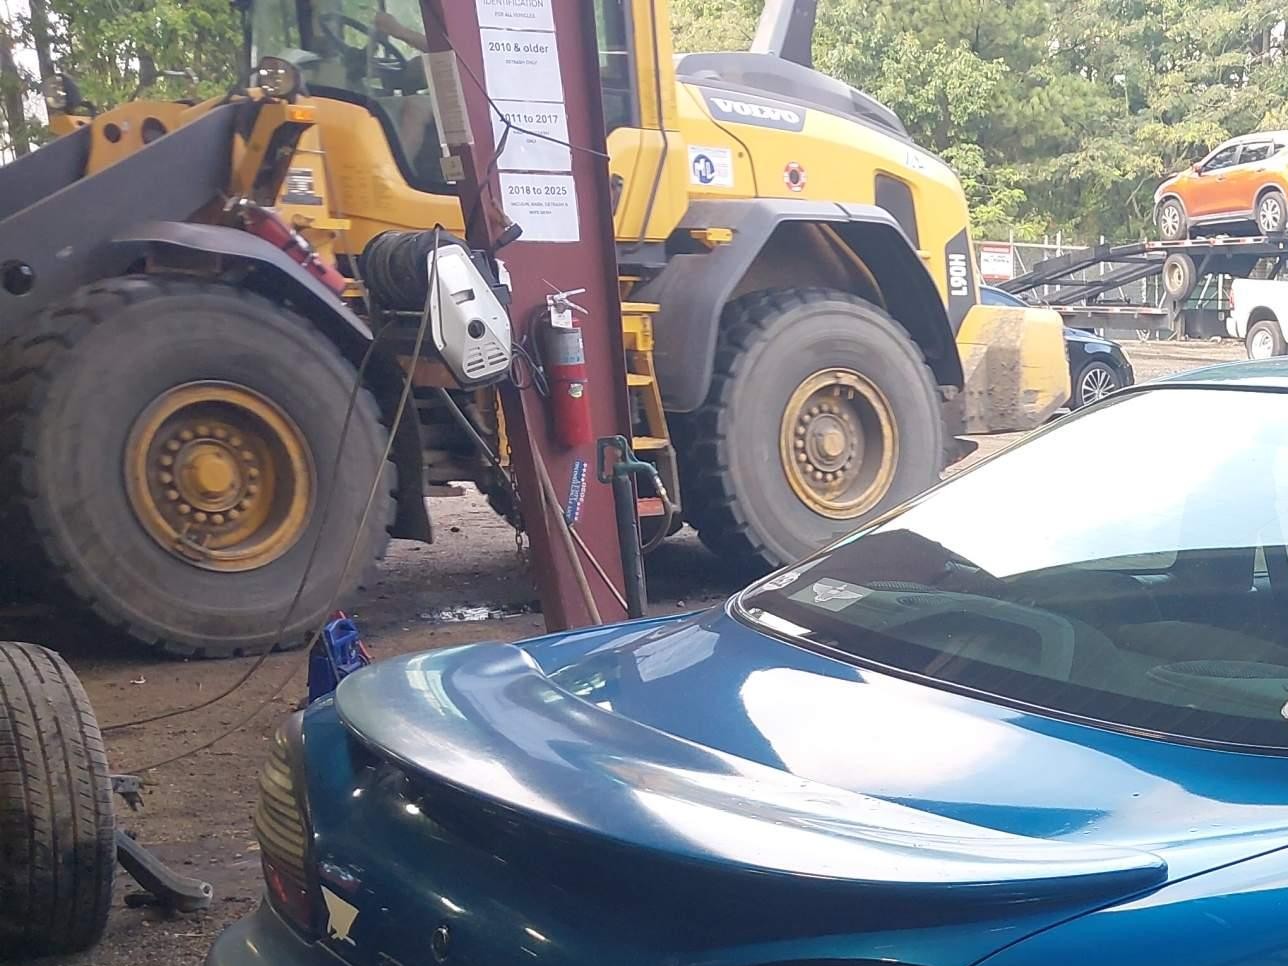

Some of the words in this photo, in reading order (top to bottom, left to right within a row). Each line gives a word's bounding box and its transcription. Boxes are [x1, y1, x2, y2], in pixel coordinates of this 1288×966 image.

[488, 42, 512, 52] 2010
[514, 42, 521, 52] &
[523, 43, 549, 53] older
[709, 97, 801, 124] VOLVO
[524, 114, 533, 123] to
[536, 114, 558, 124] 2017
[508, 185, 531, 195] 2018
[533, 186, 542, 195] to
[545, 186, 568, 196] 2025
[948, 254, 968, 296] L90H
